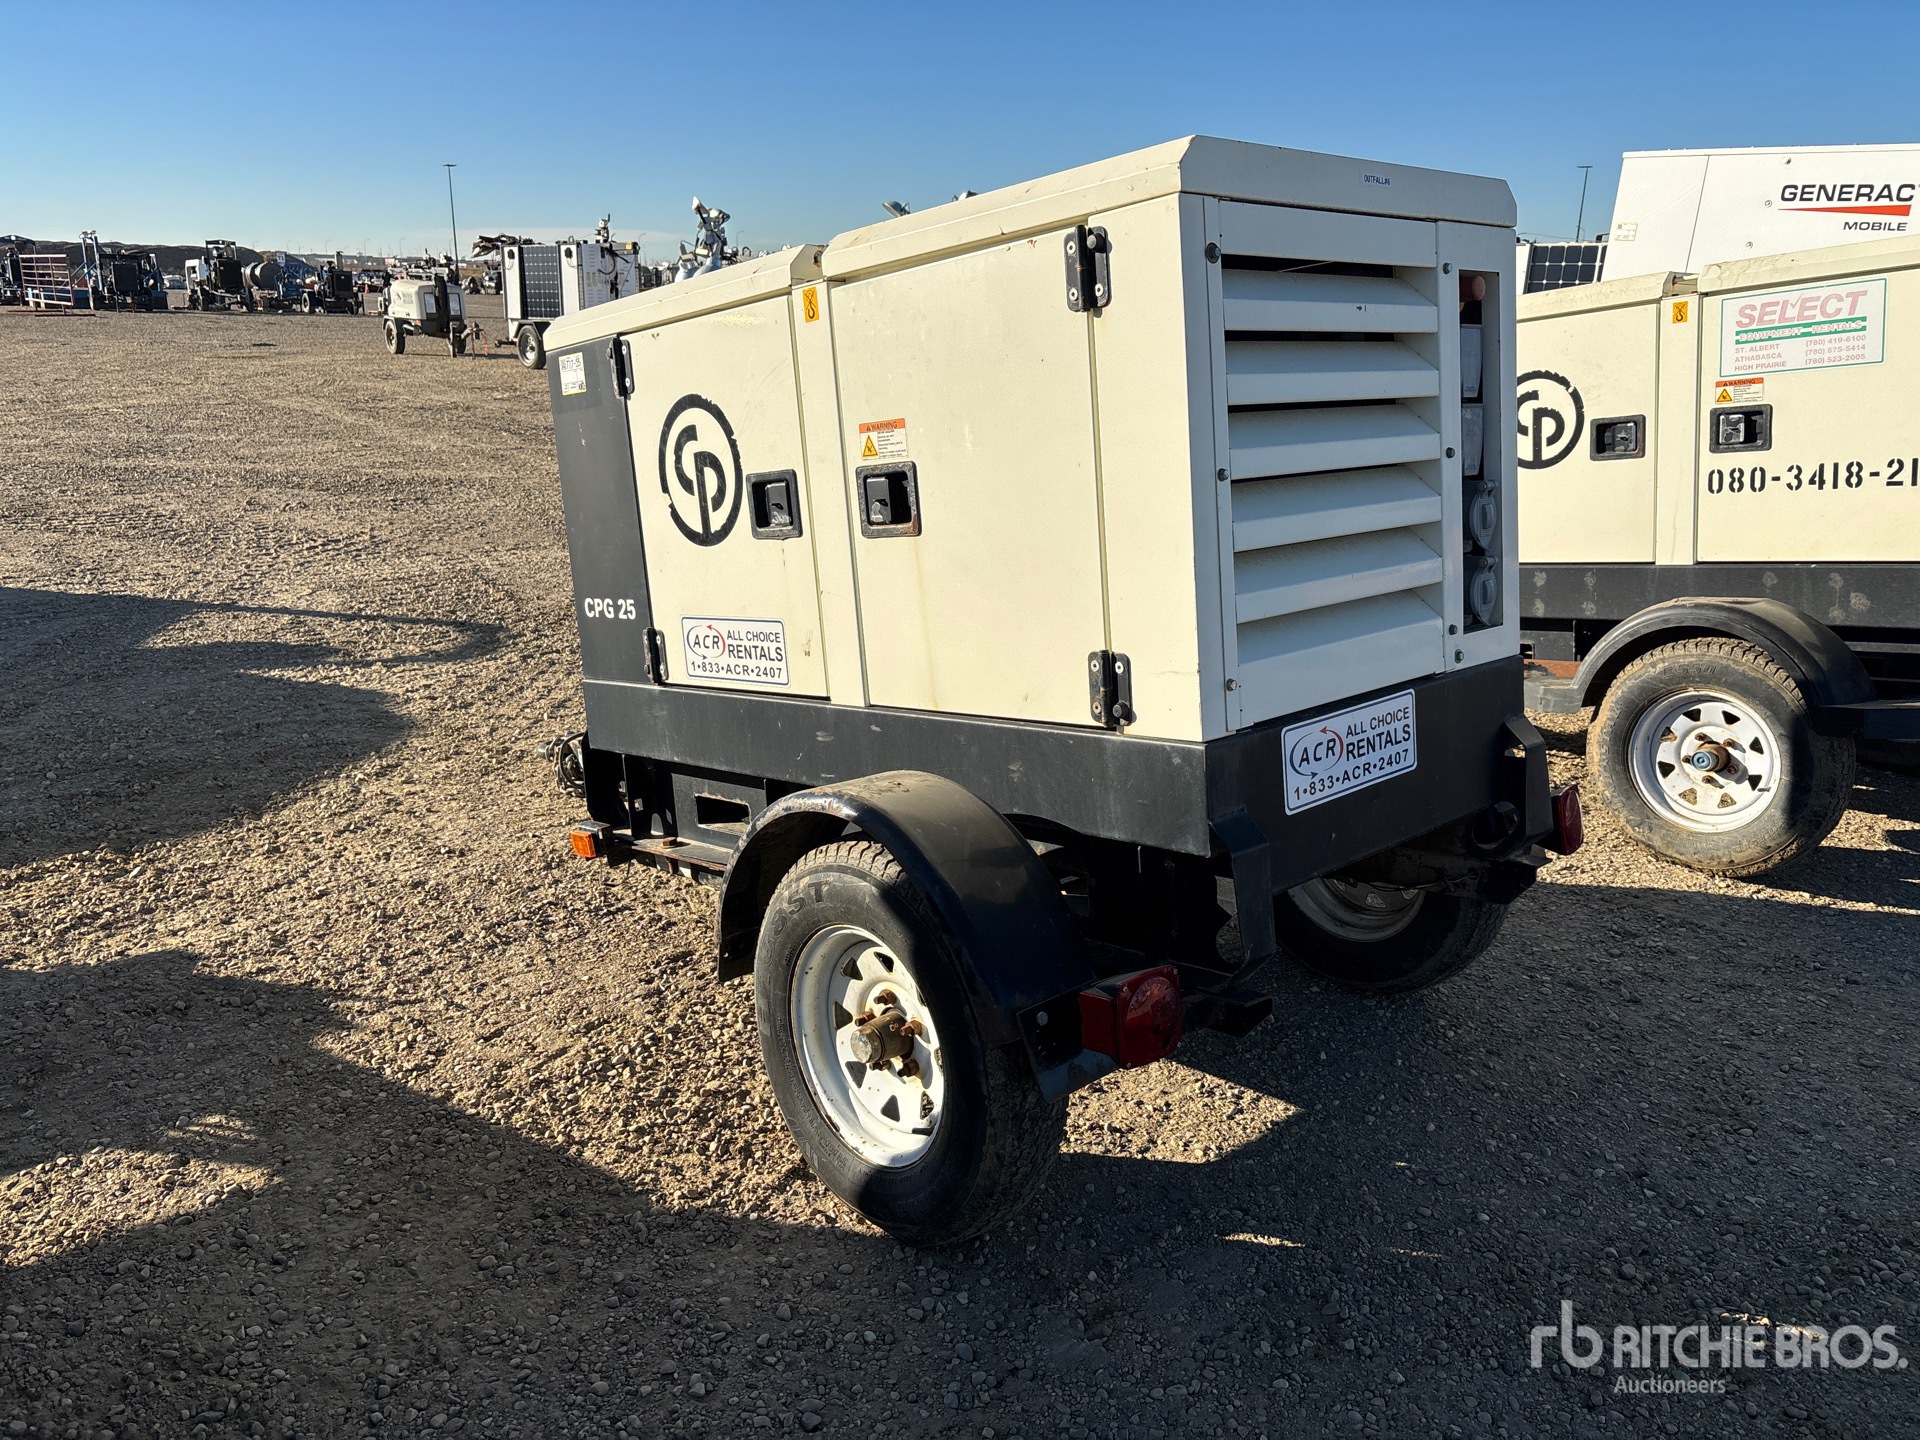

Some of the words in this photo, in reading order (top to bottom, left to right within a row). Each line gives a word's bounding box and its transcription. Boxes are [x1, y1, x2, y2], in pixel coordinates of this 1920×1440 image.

[1780, 183, 1916, 202] GENERAC
[1843, 221, 1908, 231] MOBILE
[1735, 290, 1868, 329] SELECT
[1739, 327, 1802, 342] EQUIPMENT
[1812, 320, 1862, 334] RENTALS
[1735, 346, 1747, 354] ST.
[1749, 343, 1780, 353] ALBERT
[1805, 338, 1825, 348] (780)
[1828, 334, 1866, 346] 419-6100
[1734, 352, 1782, 363] ATHABASCA
[1805, 347, 1825, 357] (780)
[1827, 344, 1866, 355] 675-5414
[1734, 364, 1754, 372] HIGH
[1755, 361, 1787, 371] PRAIRIE
[1805, 357, 1825, 366] (780)
[1827, 353, 1866, 364] 523-2005
[871, 421, 897, 431] WARNING
[1707, 457, 1919, 494] 080-3418-21
[584, 597, 615, 618] CPG
[617, 598, 637, 620] 25
[692, 634, 720, 650] ACR
[726, 629, 743, 642] ALL
[745, 631, 781, 643] CHOICE
[728, 643, 784, 662] RENTALS
[1345, 721, 1368, 739] ALL
[1369, 706, 1410, 730] CHOICE
[1346, 723, 1411, 762] RENTALS
[1298, 737, 1337, 768] ACR
